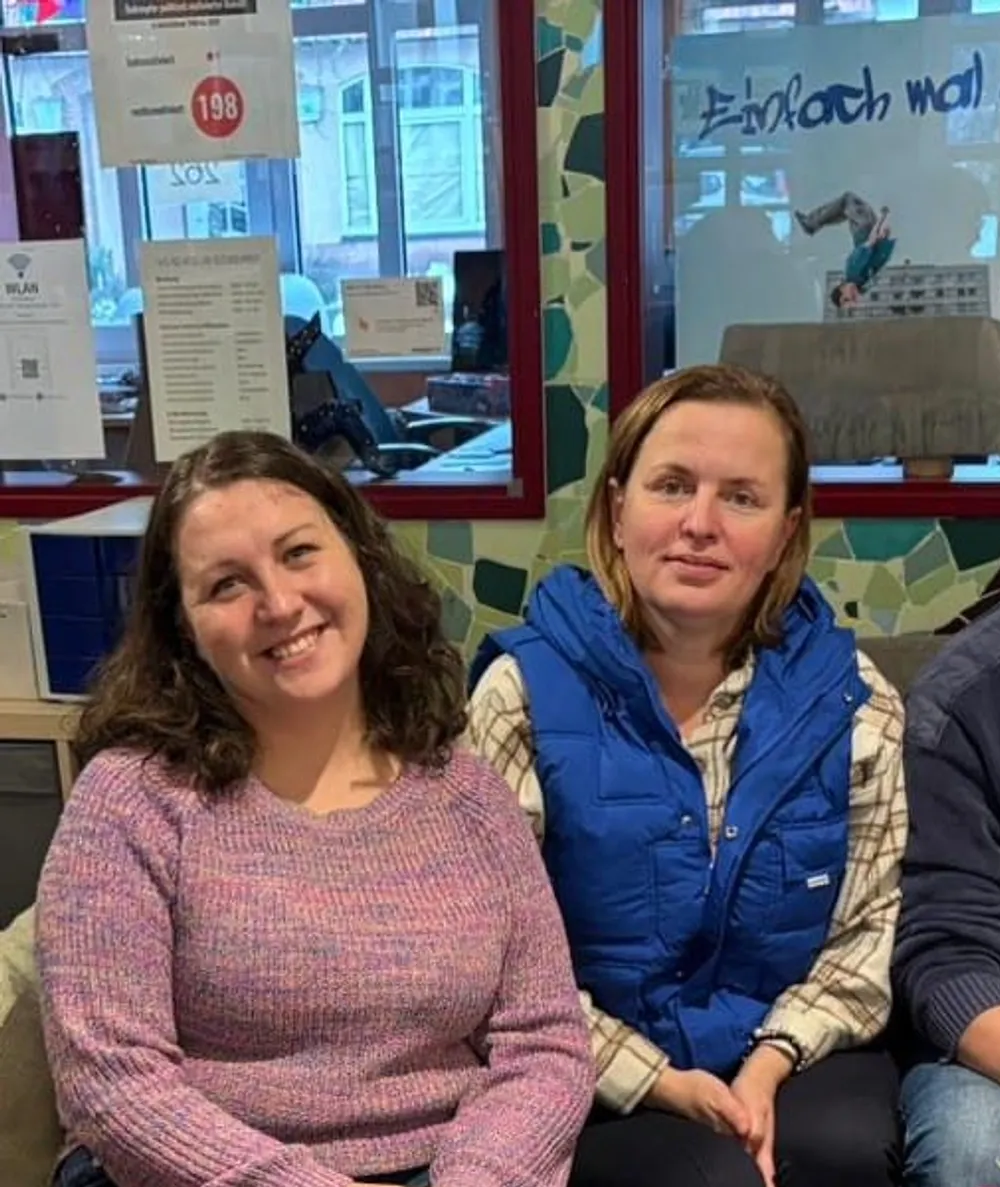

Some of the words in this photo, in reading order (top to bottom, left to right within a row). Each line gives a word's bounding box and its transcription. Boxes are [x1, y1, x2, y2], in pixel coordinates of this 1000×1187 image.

[199, 92, 238, 121] 198
[699, 65, 892, 140] Einfach
[906, 50, 984, 116] mal
